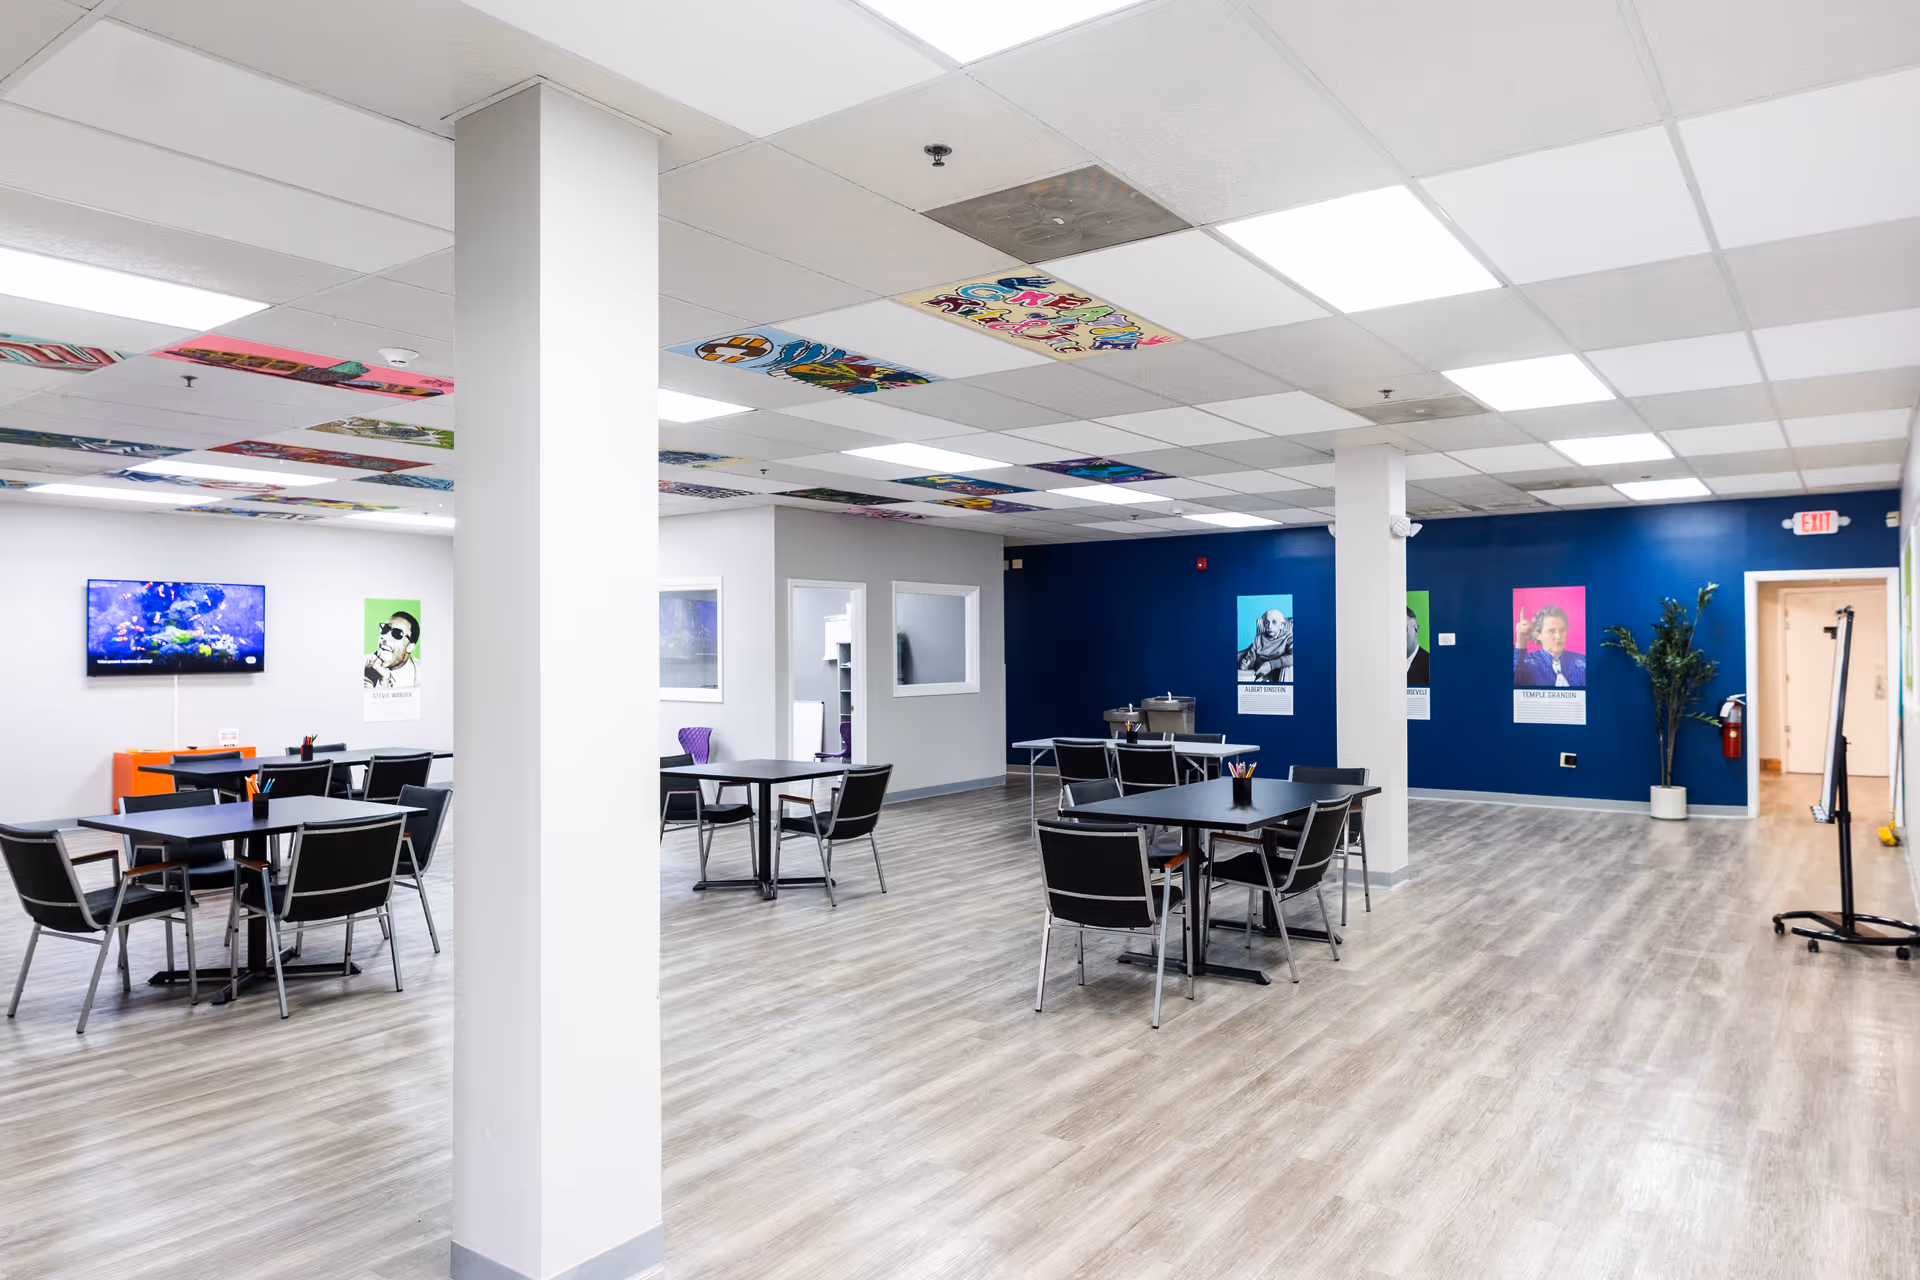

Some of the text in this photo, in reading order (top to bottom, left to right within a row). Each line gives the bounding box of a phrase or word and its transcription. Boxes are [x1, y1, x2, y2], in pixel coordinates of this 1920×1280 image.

[956, 283, 1142, 351] CREATIVE
[1801, 512, 1832, 533] EXIT
[1522, 691, 1577, 699] TEMPLE GRANDIN
